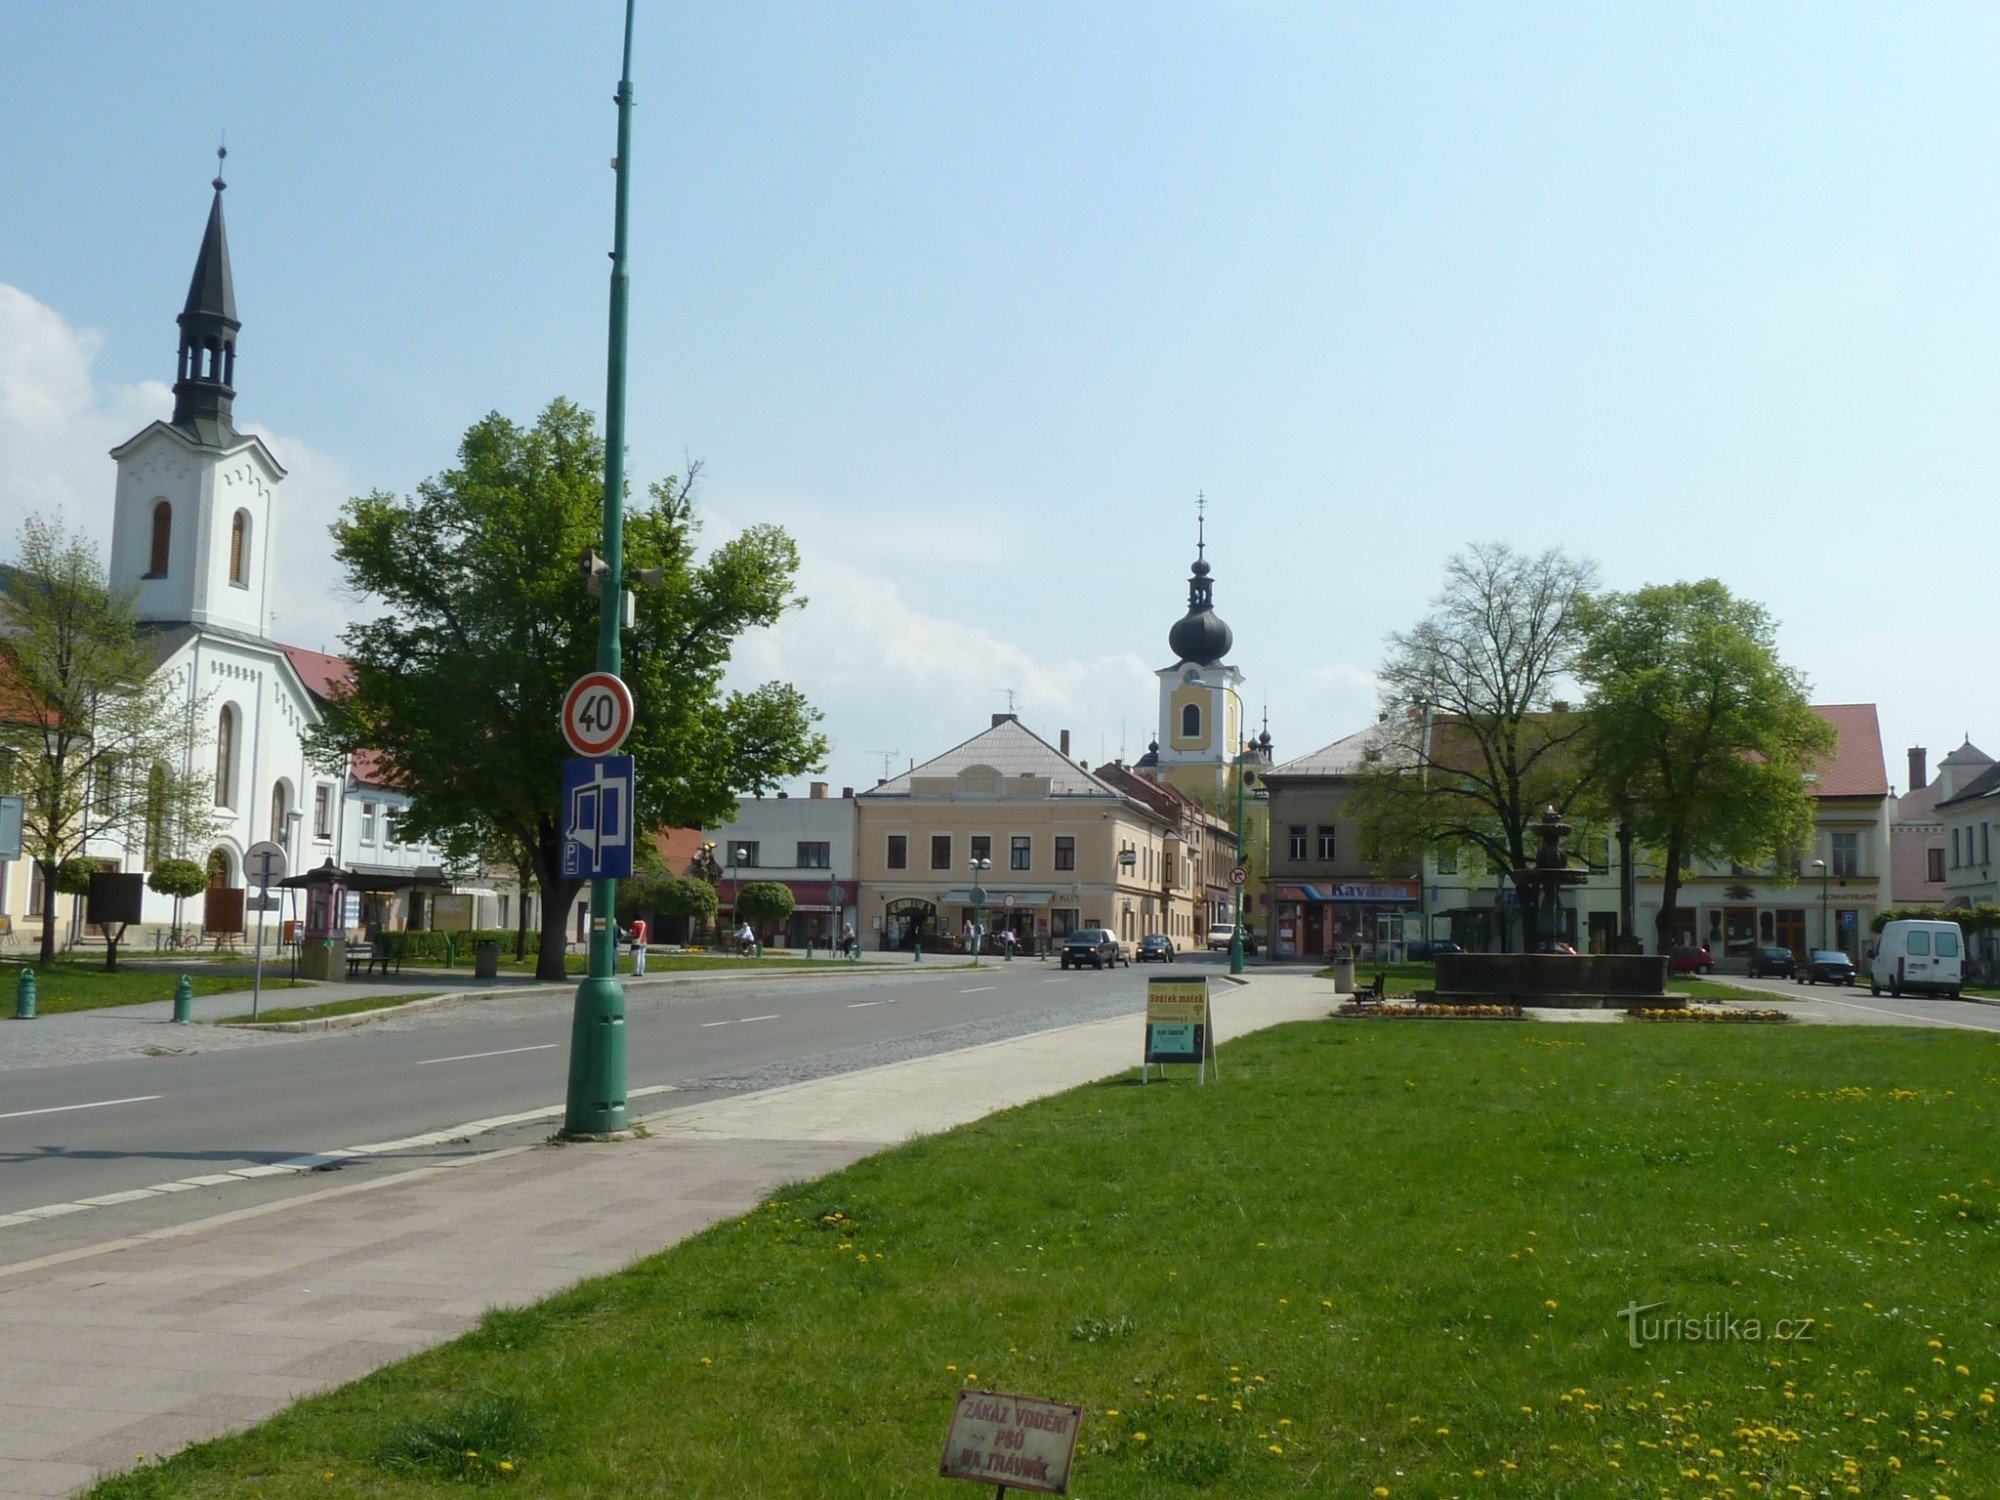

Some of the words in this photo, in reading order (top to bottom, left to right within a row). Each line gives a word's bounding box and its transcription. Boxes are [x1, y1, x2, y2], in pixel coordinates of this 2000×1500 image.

[579, 695, 613, 732] 40
[567, 844, 576, 860] P
[1844, 914, 1853, 924] P
[963, 1400, 1010, 1424] ZÁKAZ
[994, 1428, 1026, 1451] PSŮ
[961, 1448, 982, 1469] NA
